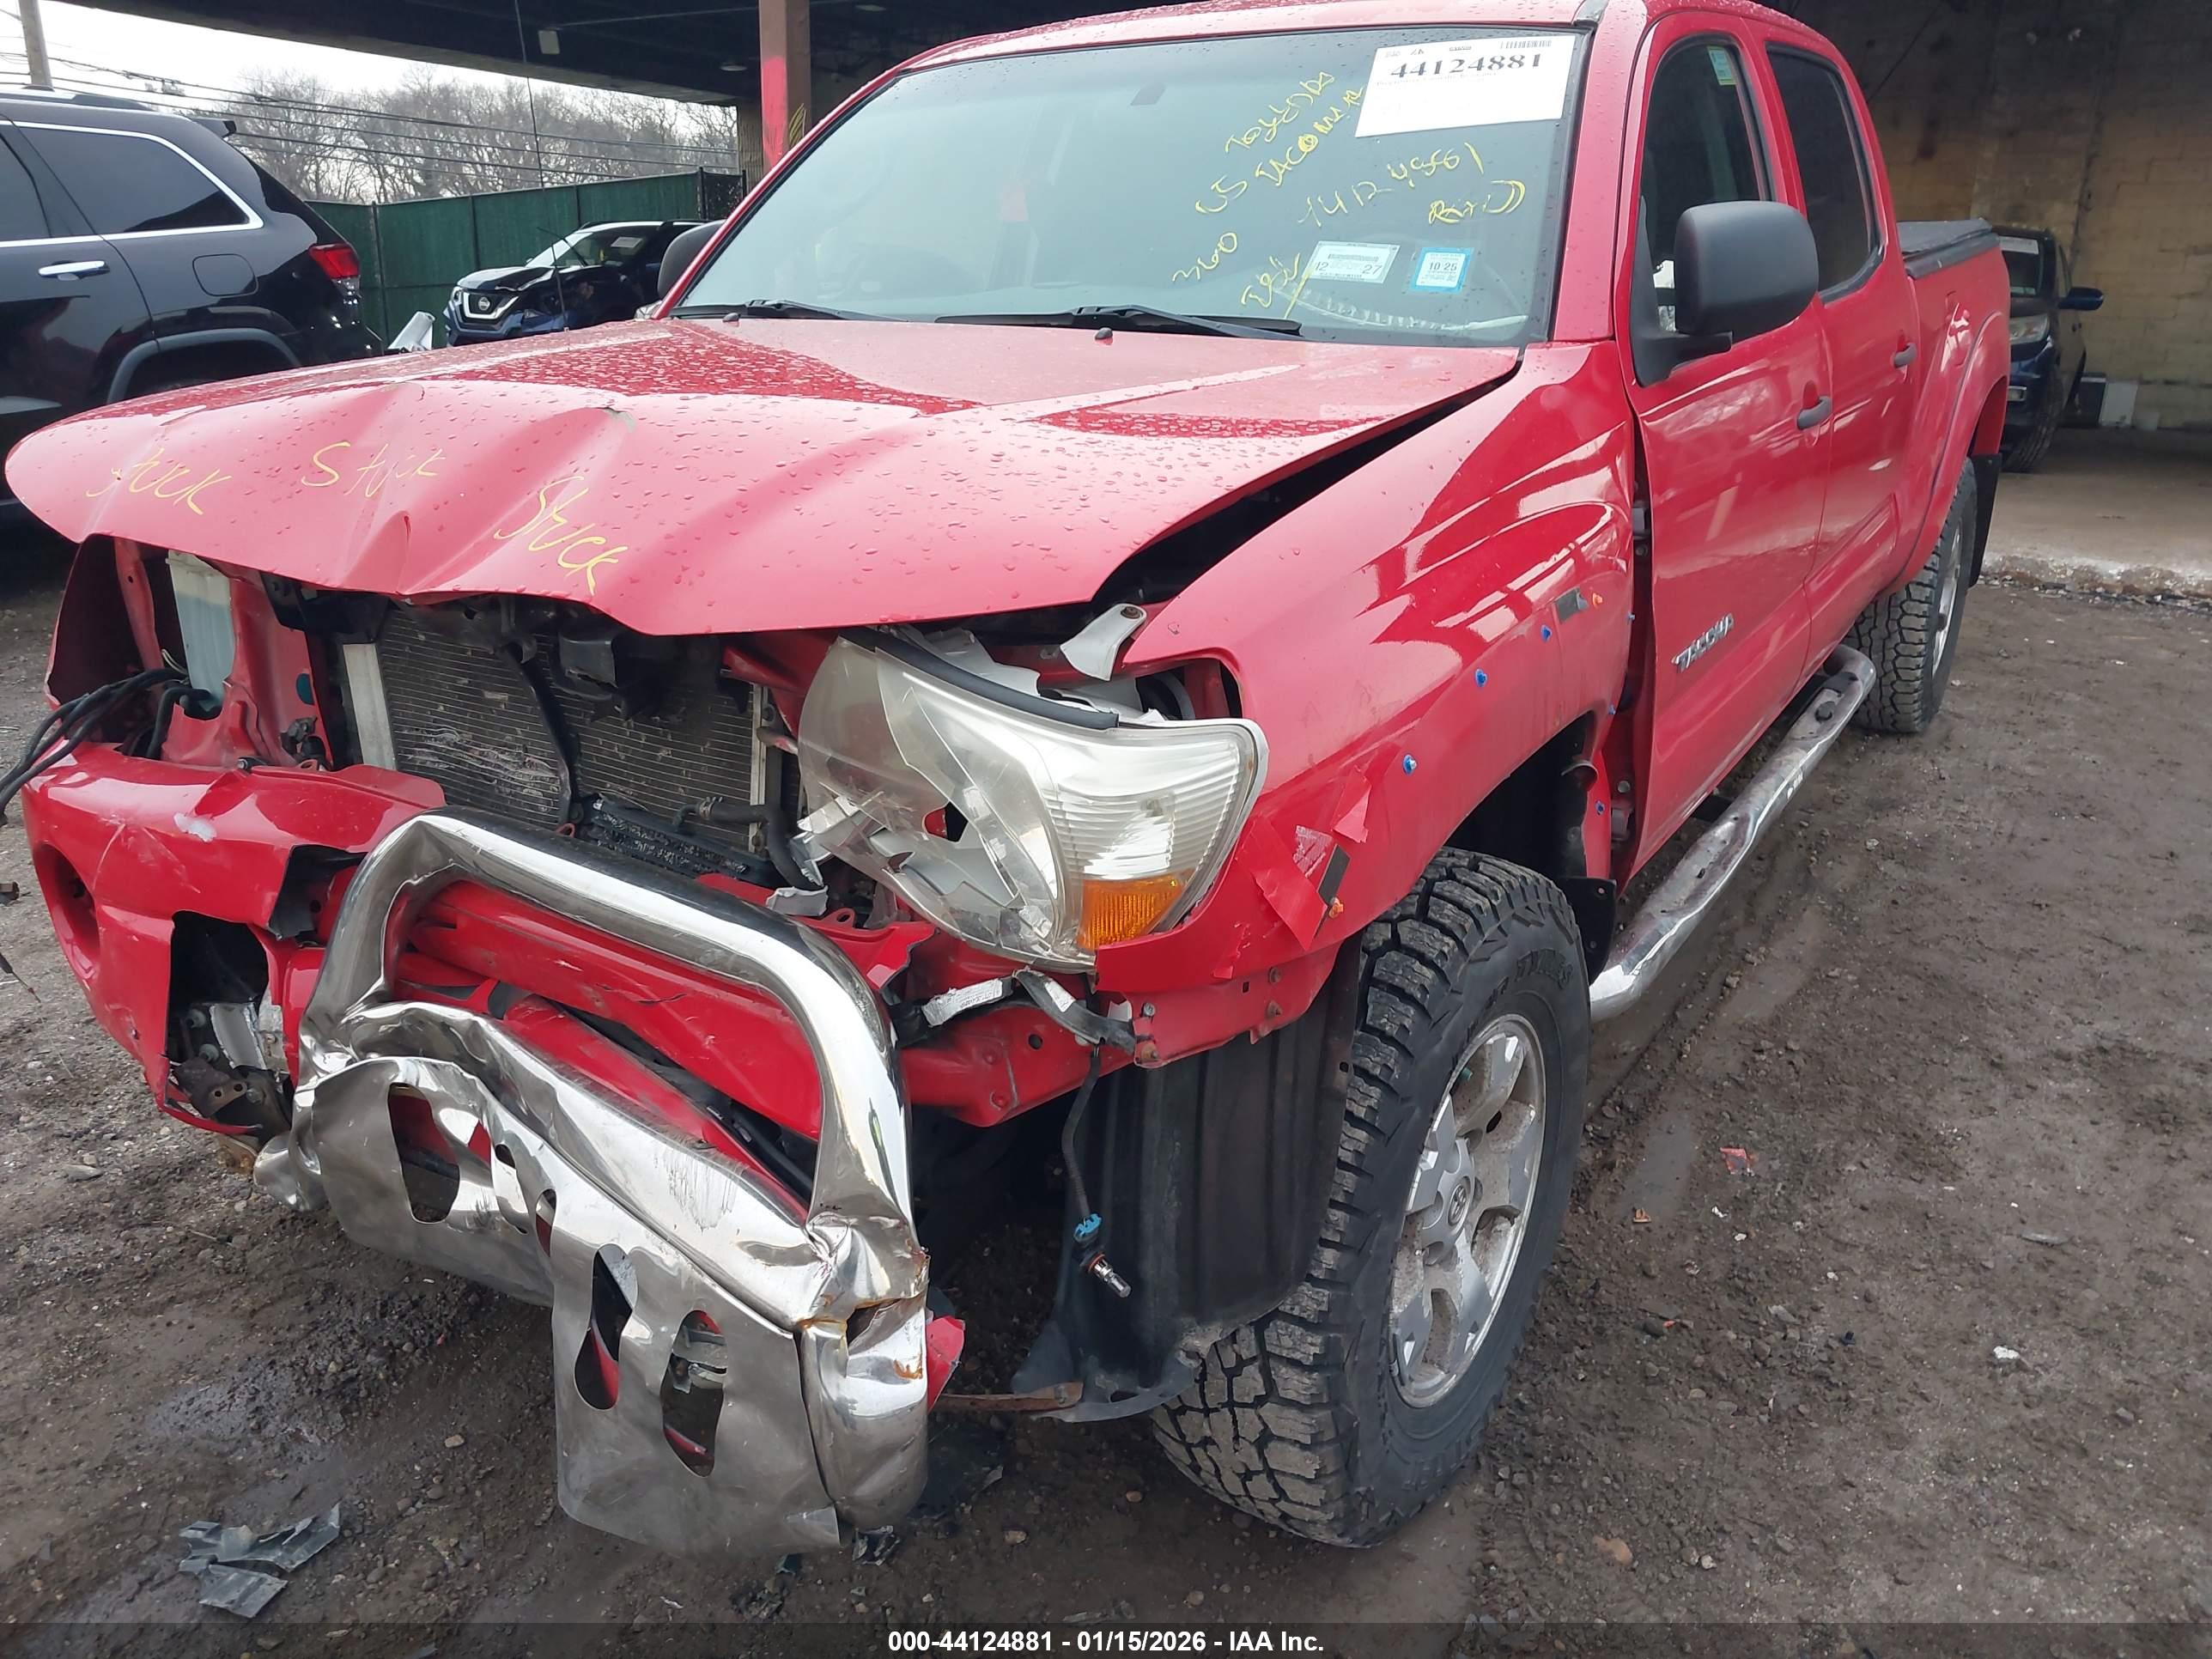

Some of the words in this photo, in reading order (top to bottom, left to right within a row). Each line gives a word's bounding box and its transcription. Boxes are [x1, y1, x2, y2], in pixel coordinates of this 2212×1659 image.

[1390, 53, 1541, 78] 44124881
[1362, 264, 1383, 276] 27
[1429, 261, 1441, 270] 10
[1443, 262, 1458, 272] 25
